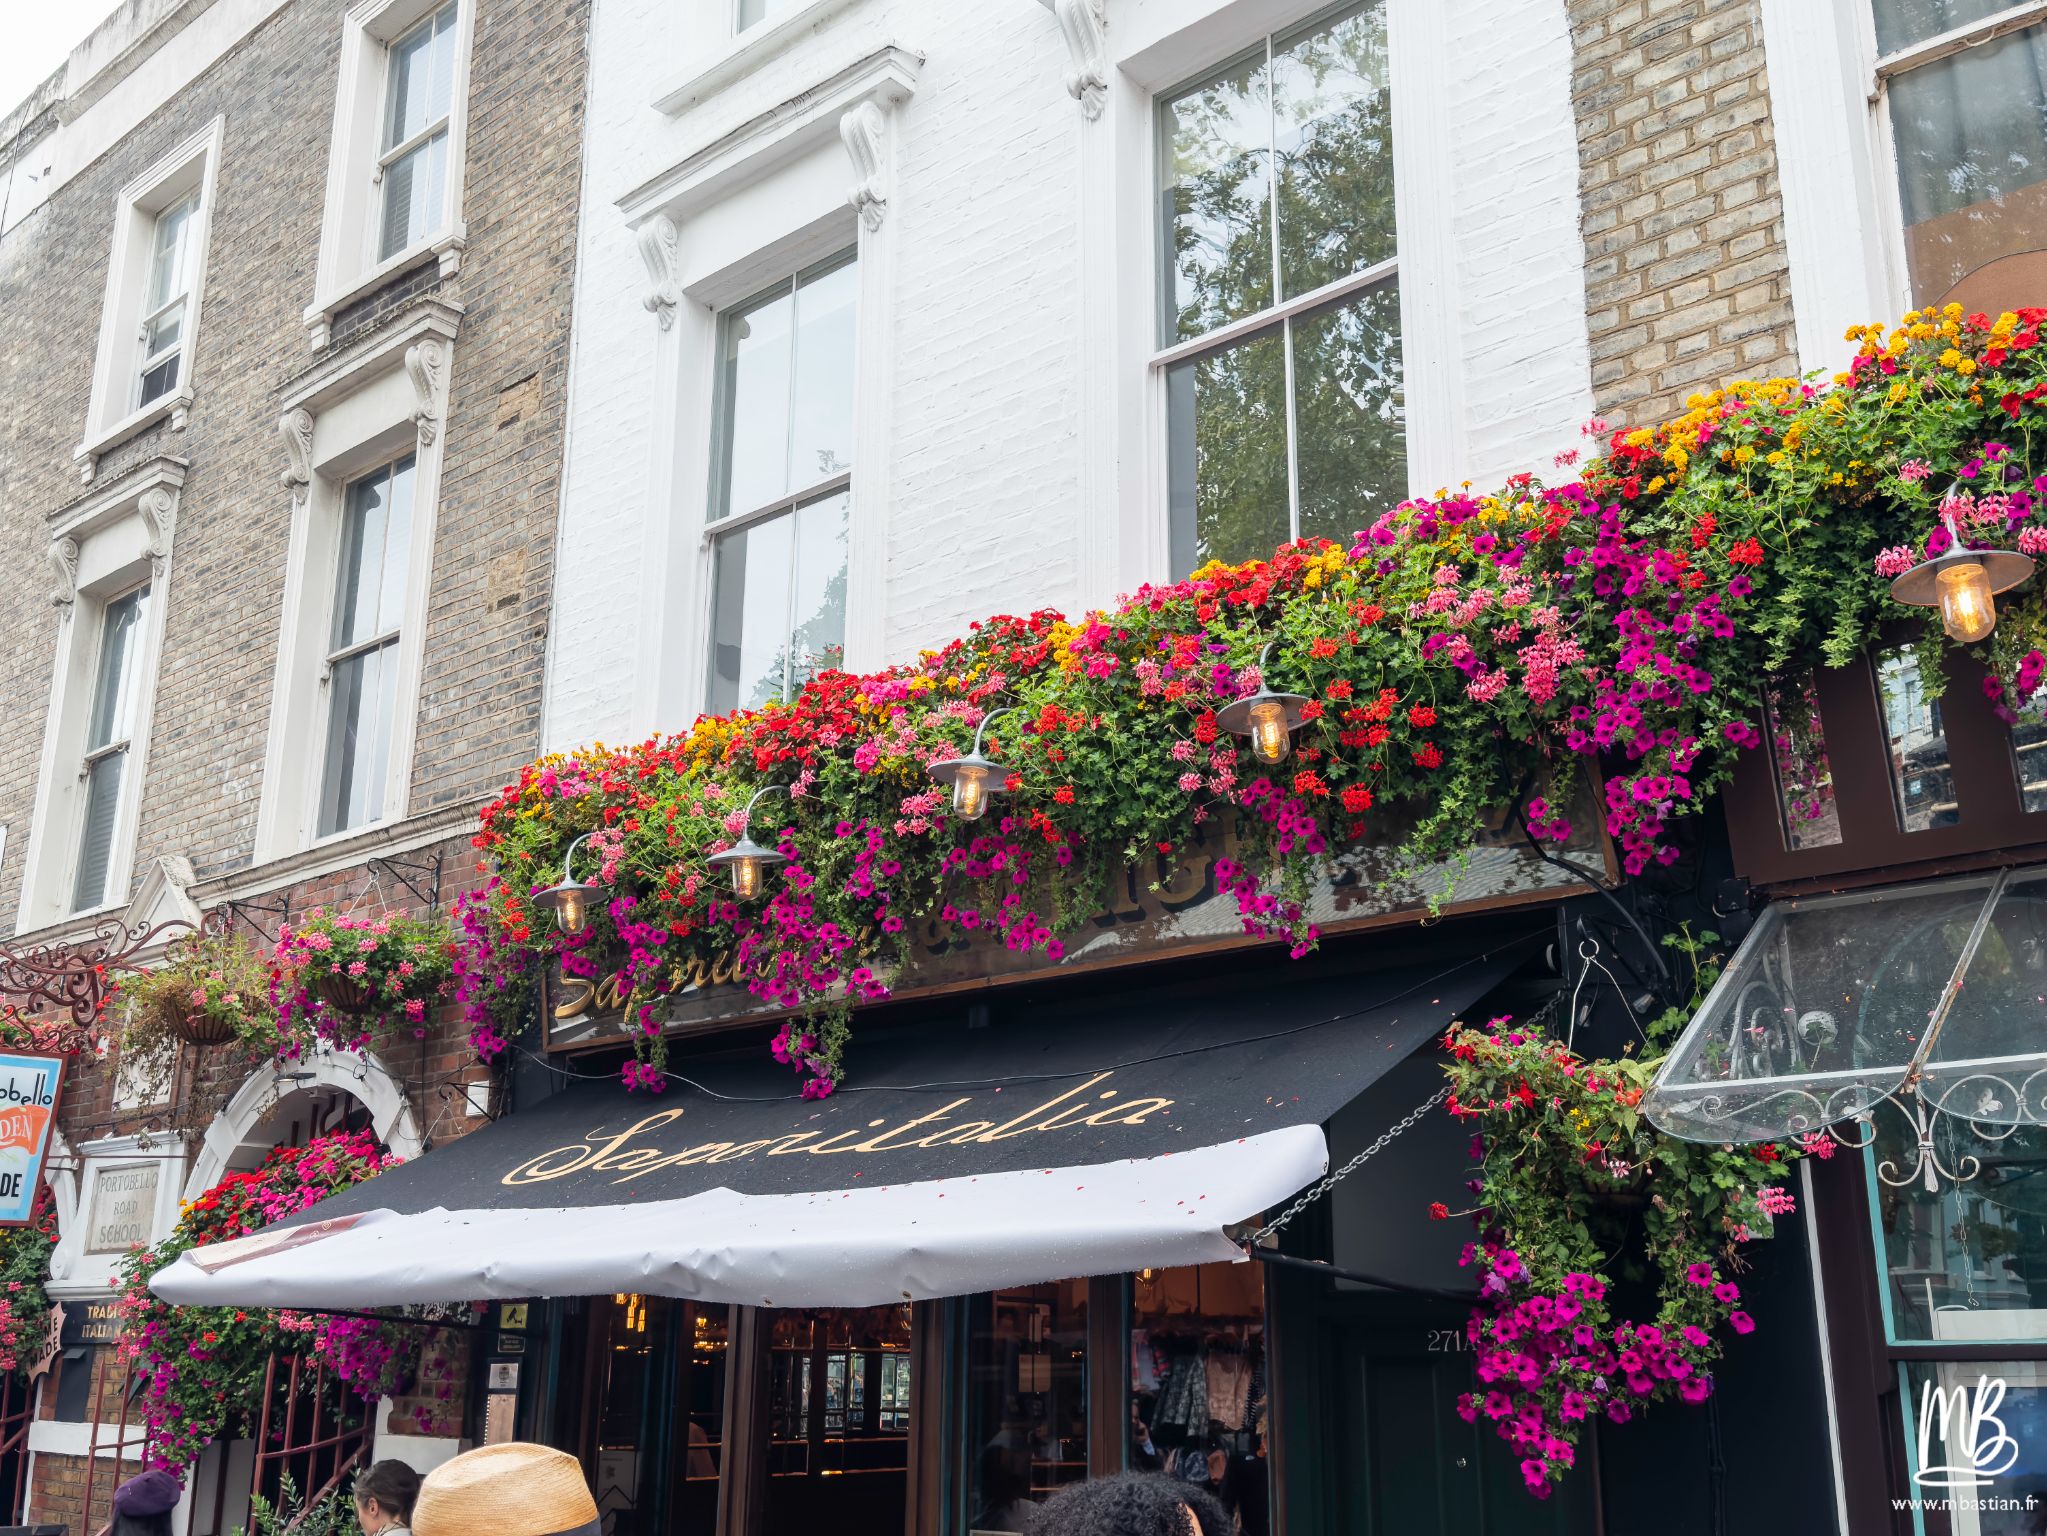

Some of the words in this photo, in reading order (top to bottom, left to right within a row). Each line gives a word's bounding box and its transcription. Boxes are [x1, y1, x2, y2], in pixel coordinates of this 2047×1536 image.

[501, 1071, 1176, 1185] Saporitalia
[100, 1172, 159, 1193] PORTOBELLO
[113, 1200, 138, 1216] ROAD
[99, 1223, 143, 1244] SCHOOL
